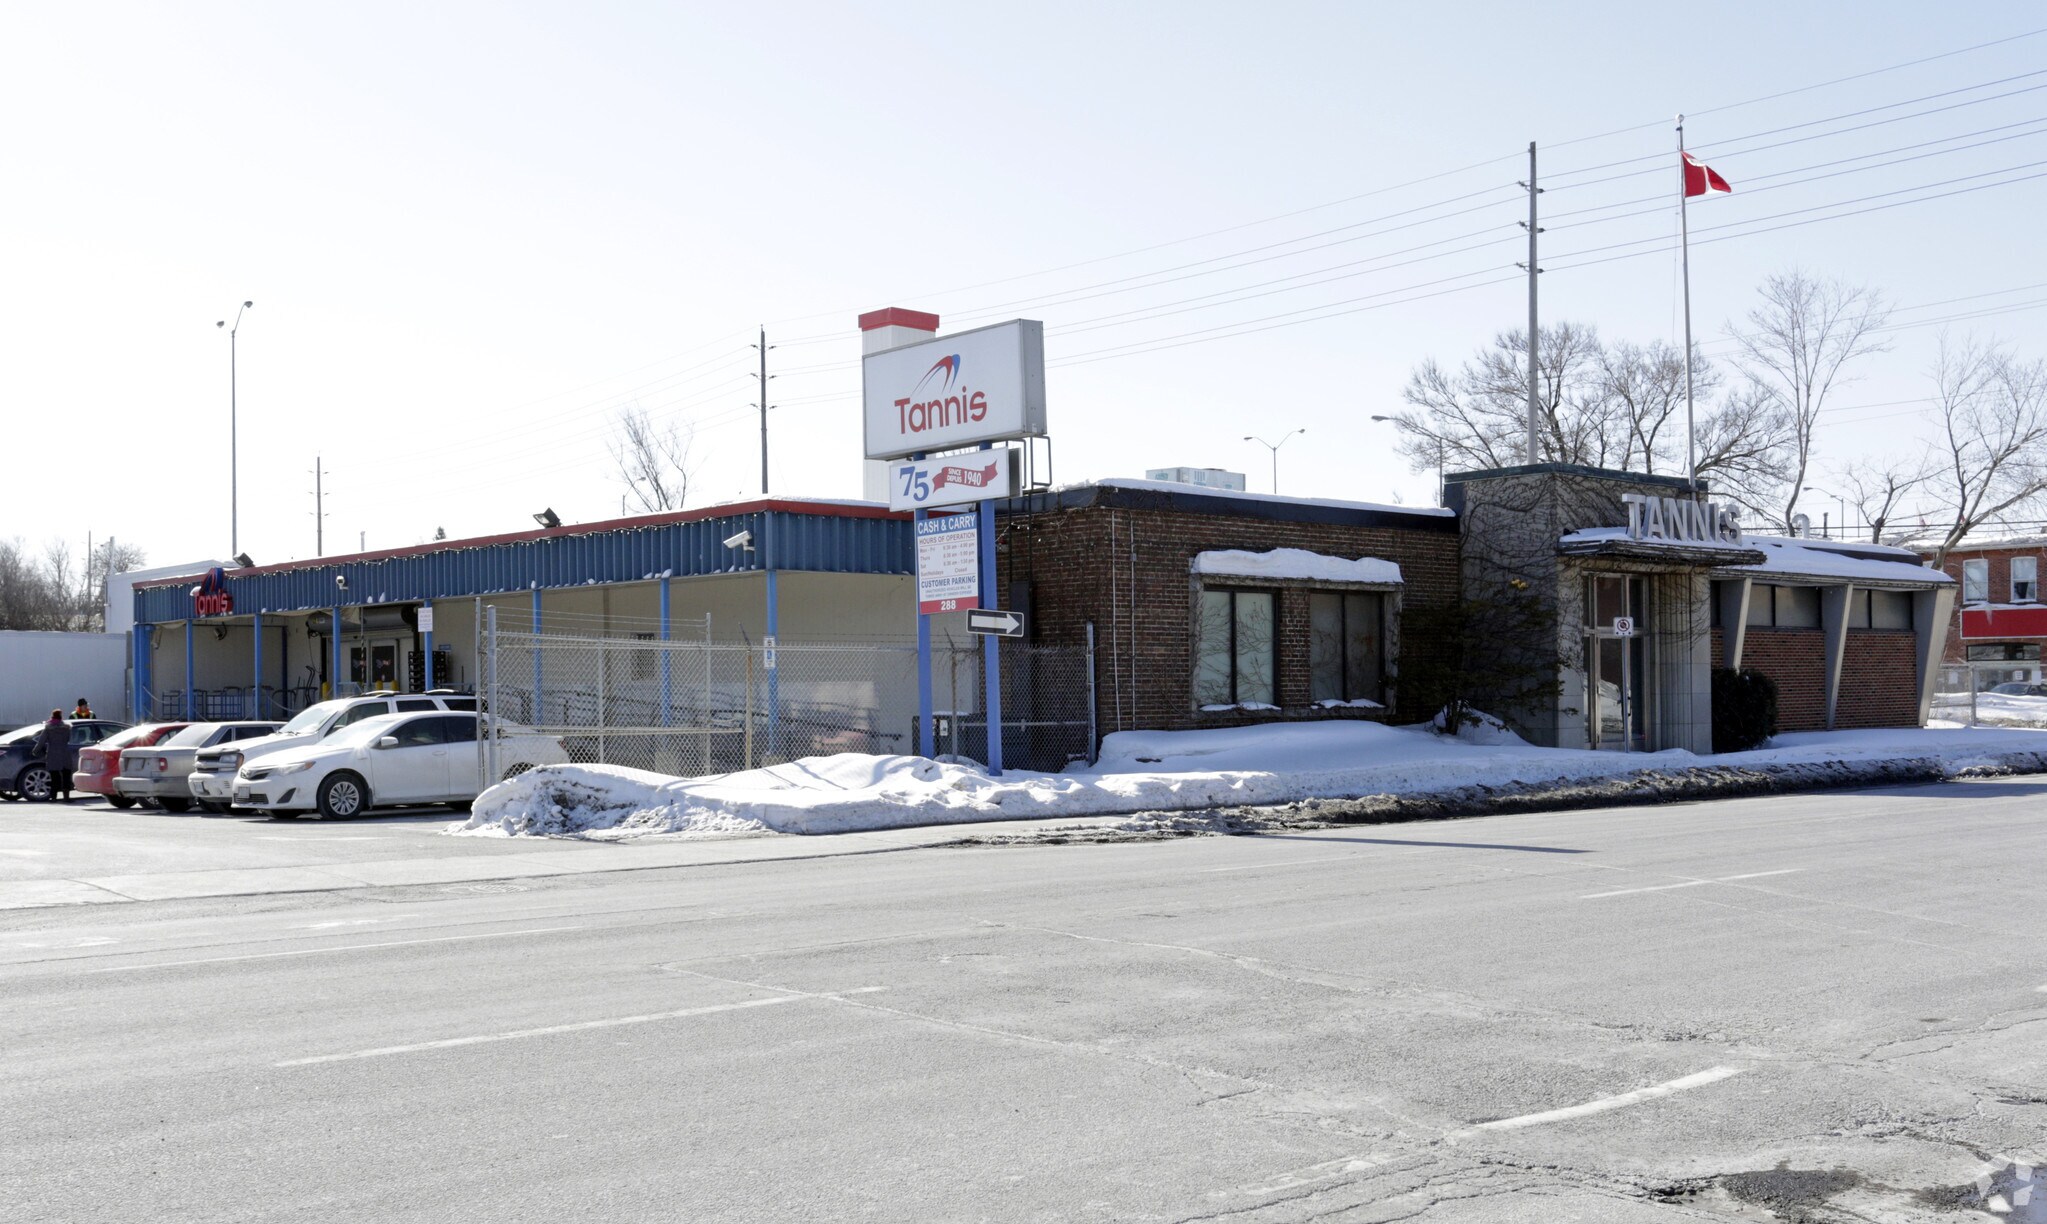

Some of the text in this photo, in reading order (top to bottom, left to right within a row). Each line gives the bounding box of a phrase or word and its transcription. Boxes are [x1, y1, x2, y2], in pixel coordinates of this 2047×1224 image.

[894, 385, 987, 434] Tannis
[899, 466, 929, 502] 75
[964, 470, 982, 486] 1940
[918, 514, 976, 535] CASH & CARRY
[1622, 493, 1743, 546] TANNIS
[946, 532, 976, 542] OPERATION
[921, 576, 976, 588] CUSTOMER PARKING
[941, 600, 956, 610] 288
